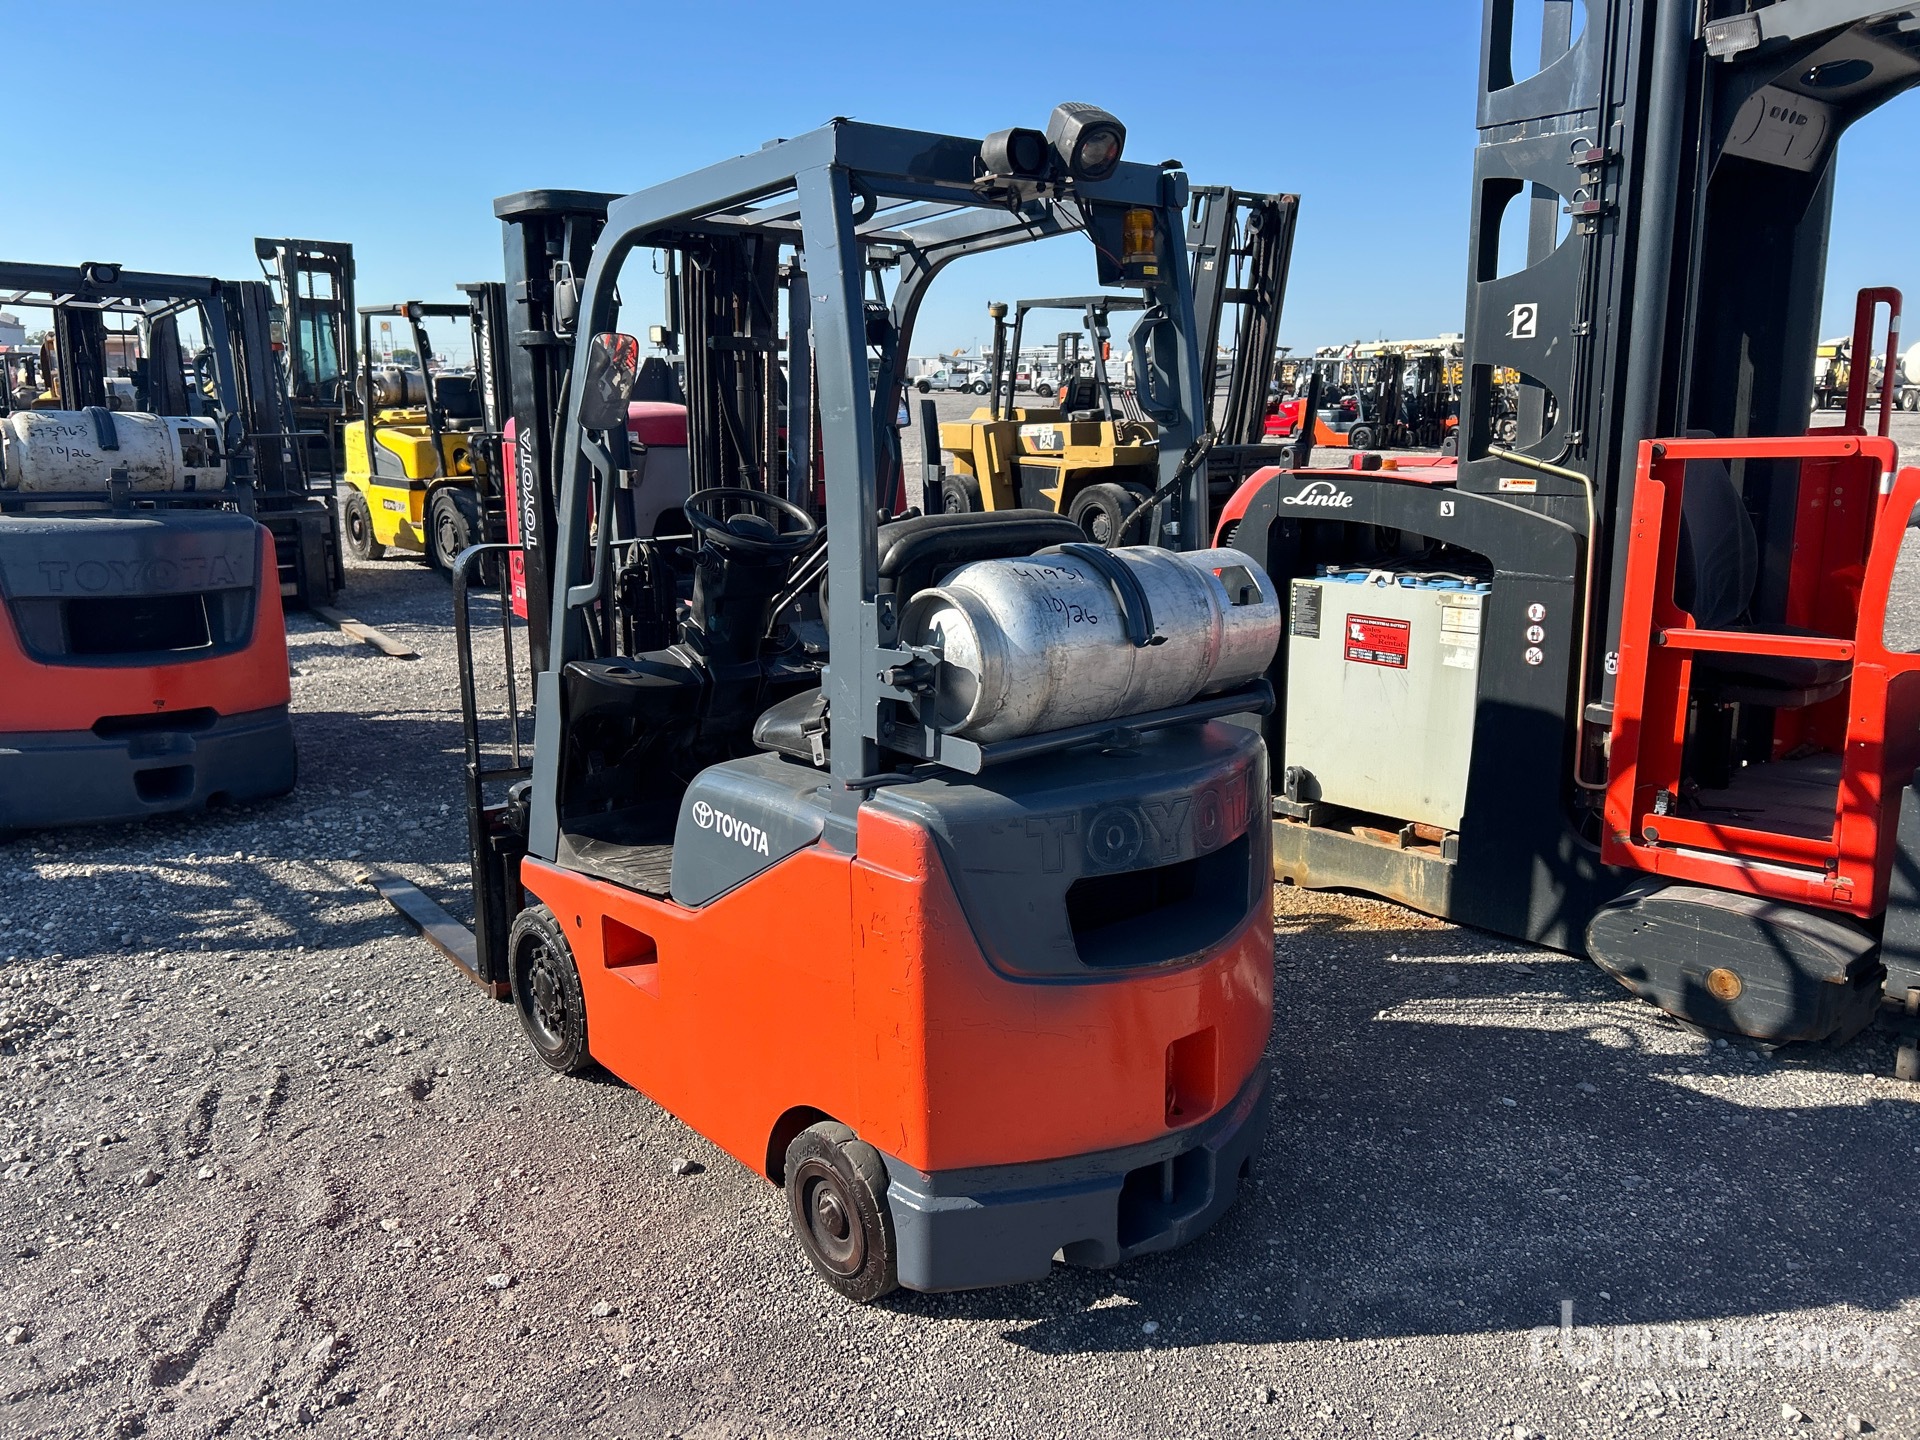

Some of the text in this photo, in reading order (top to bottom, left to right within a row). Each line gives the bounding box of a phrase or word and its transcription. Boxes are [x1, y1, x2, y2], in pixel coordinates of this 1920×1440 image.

[1516, 306, 1534, 336] 2
[481, 319, 494, 396] HYUNDAI
[48, 446, 92, 462] 10/26
[1040, 434, 1056, 449] CAT
[520, 427, 537, 550] TOYOTA
[1282, 481, 1353, 508] Linde
[38, 556, 236, 591] TOYOTA
[1013, 567, 1084, 582] 41931
[1042, 596, 1098, 628] 10/26
[1361, 625, 1382, 634] Sales
[1369, 631, 1398, 641] Service
[1378, 638, 1407, 648] Rentals
[714, 809, 769, 857] TOYOTA
